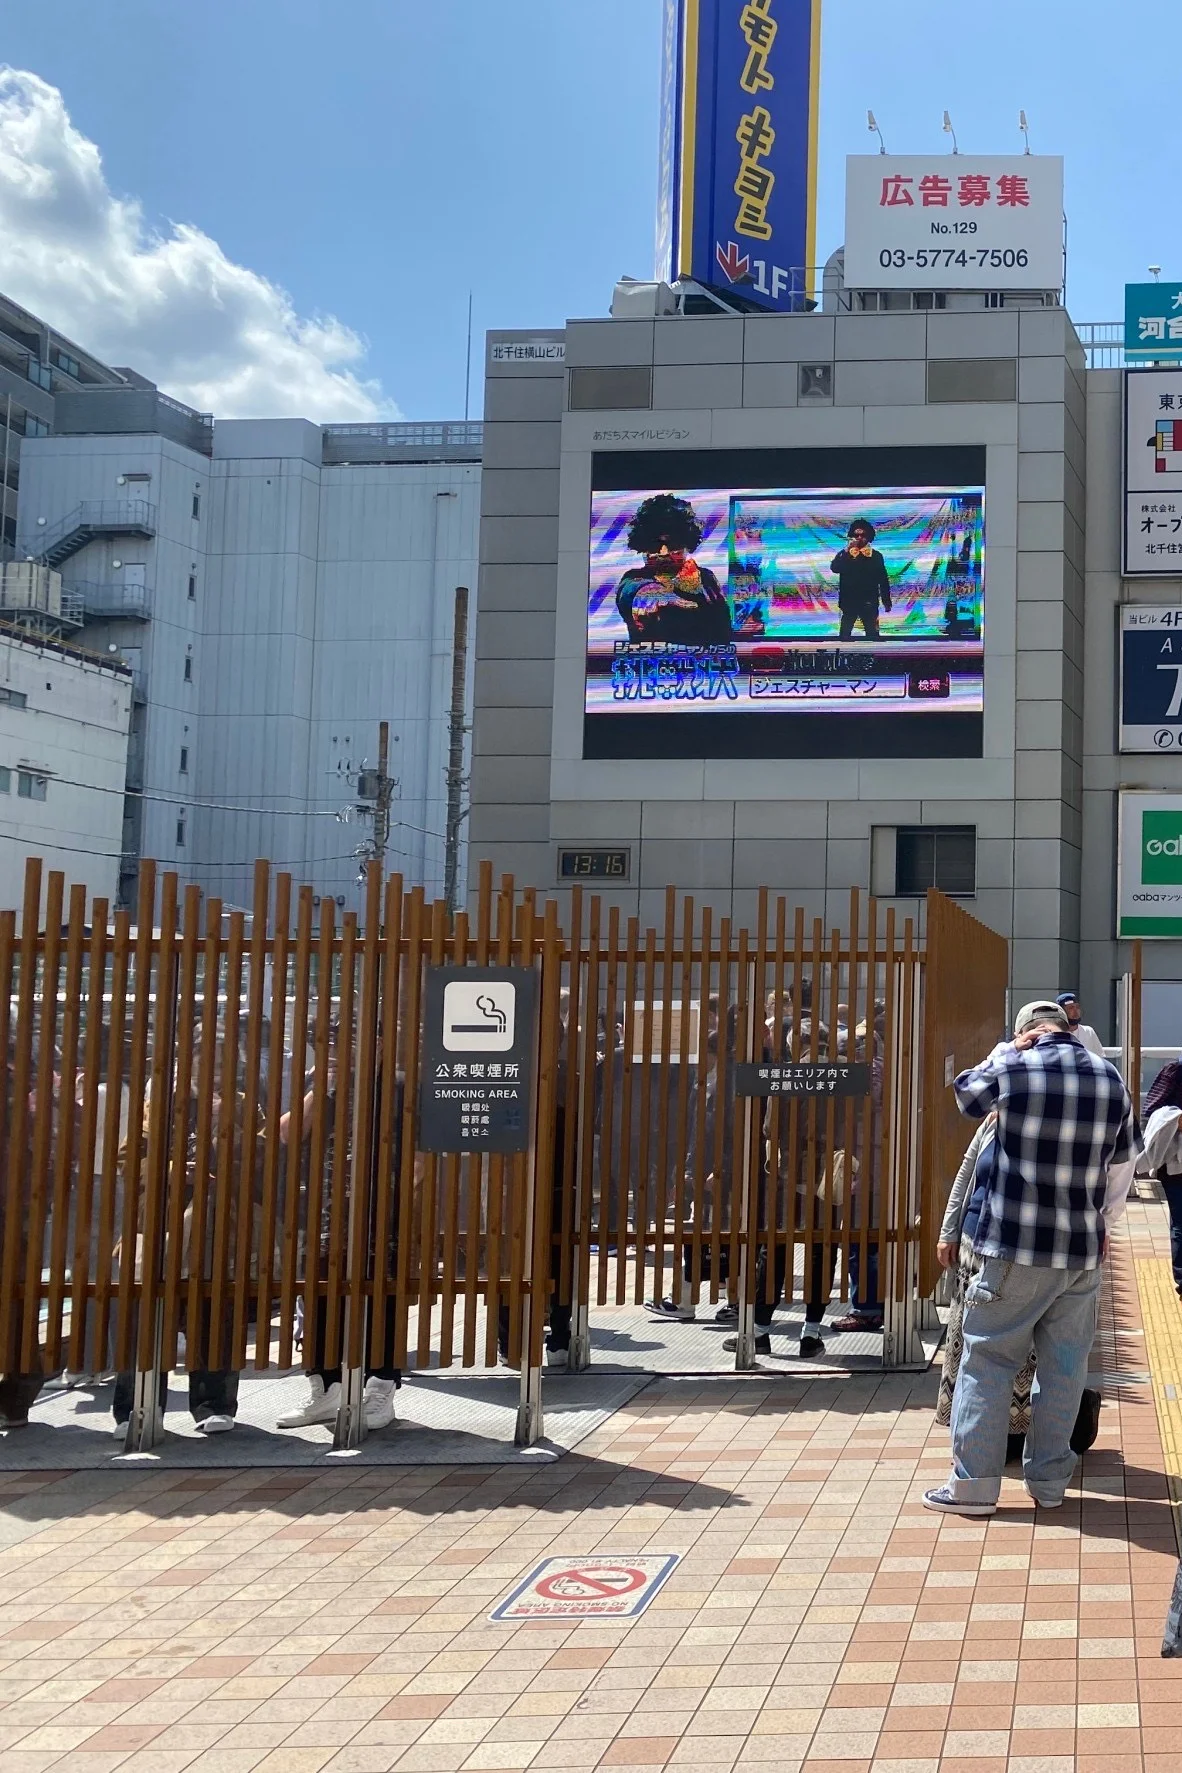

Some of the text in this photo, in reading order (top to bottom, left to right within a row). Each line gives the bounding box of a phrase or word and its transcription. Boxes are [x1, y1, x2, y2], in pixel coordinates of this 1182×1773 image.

[735, 0, 777, 240] モトキヨシ
[879, 174, 1030, 207] 広告募集
[930, 222, 978, 235] No.129
[879, 249, 1029, 268] 03-5774-7506
[753, 260, 788, 299] 1F
[493, 346, 566, 359] 北千住横山ビル
[593, 428, 690, 441] あだちスマイルビジョン
[1141, 504, 1176, 513] 株式会社
[1128, 614, 1157, 625] 当ビル
[753, 677, 878, 695] ジェスチャーマン
[917, 679, 941, 692] 検索
[435, 1063, 519, 1078] 公衆喫煙所
[758, 1068, 849, 1079] 喫煙はエリア内で
[770, 1081, 837, 1091] お願いします
[434, 1089, 518, 1099] SMOKING AREA
